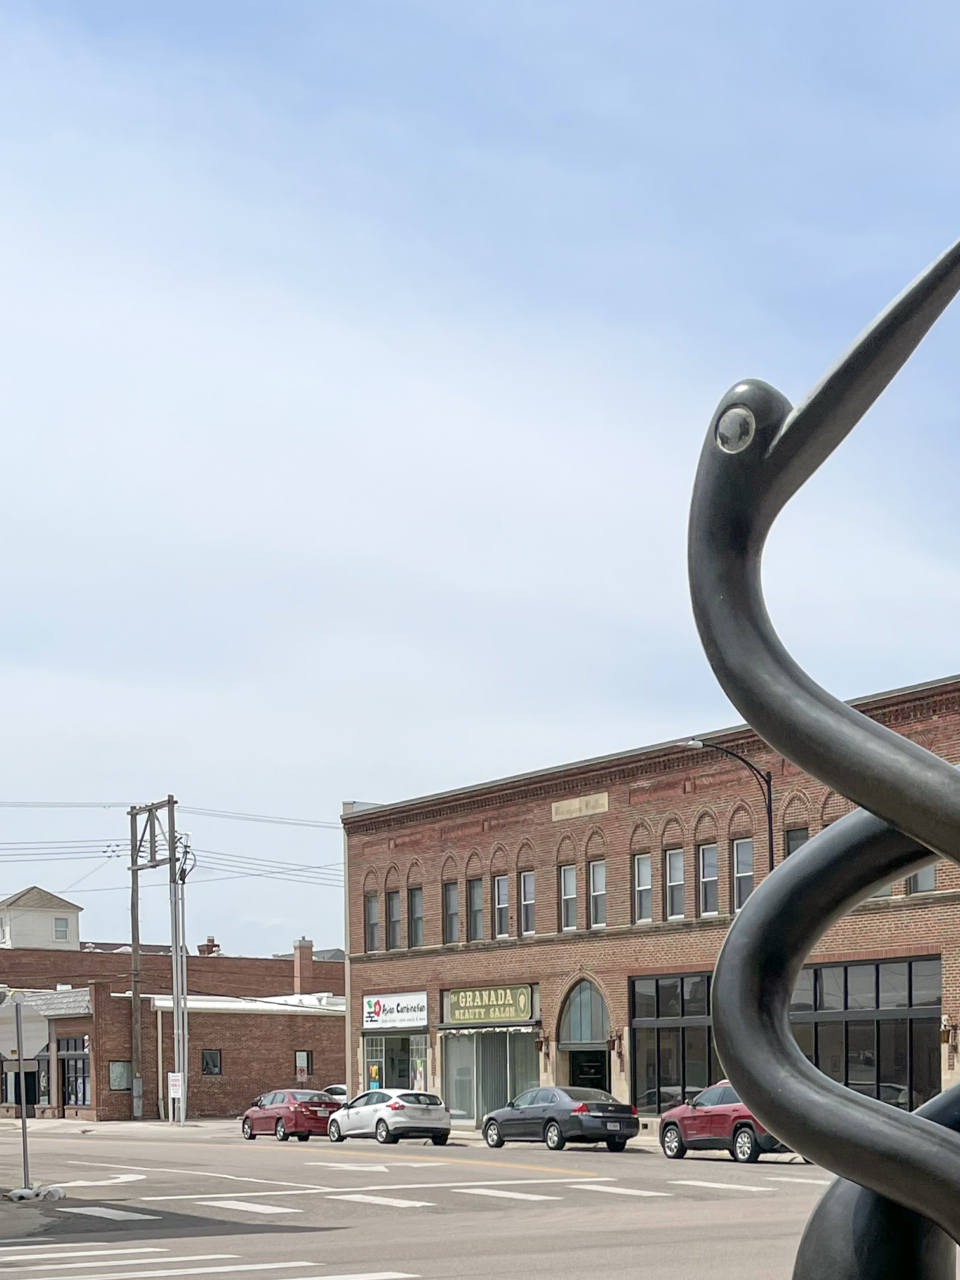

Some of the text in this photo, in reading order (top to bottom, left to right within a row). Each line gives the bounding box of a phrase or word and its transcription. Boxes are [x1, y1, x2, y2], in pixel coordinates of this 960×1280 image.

[459, 989, 514, 1007] GRANADA
[382, 1004, 395, 1016] Asian
[455, 1007, 516, 1019] BEAUTY SALON
